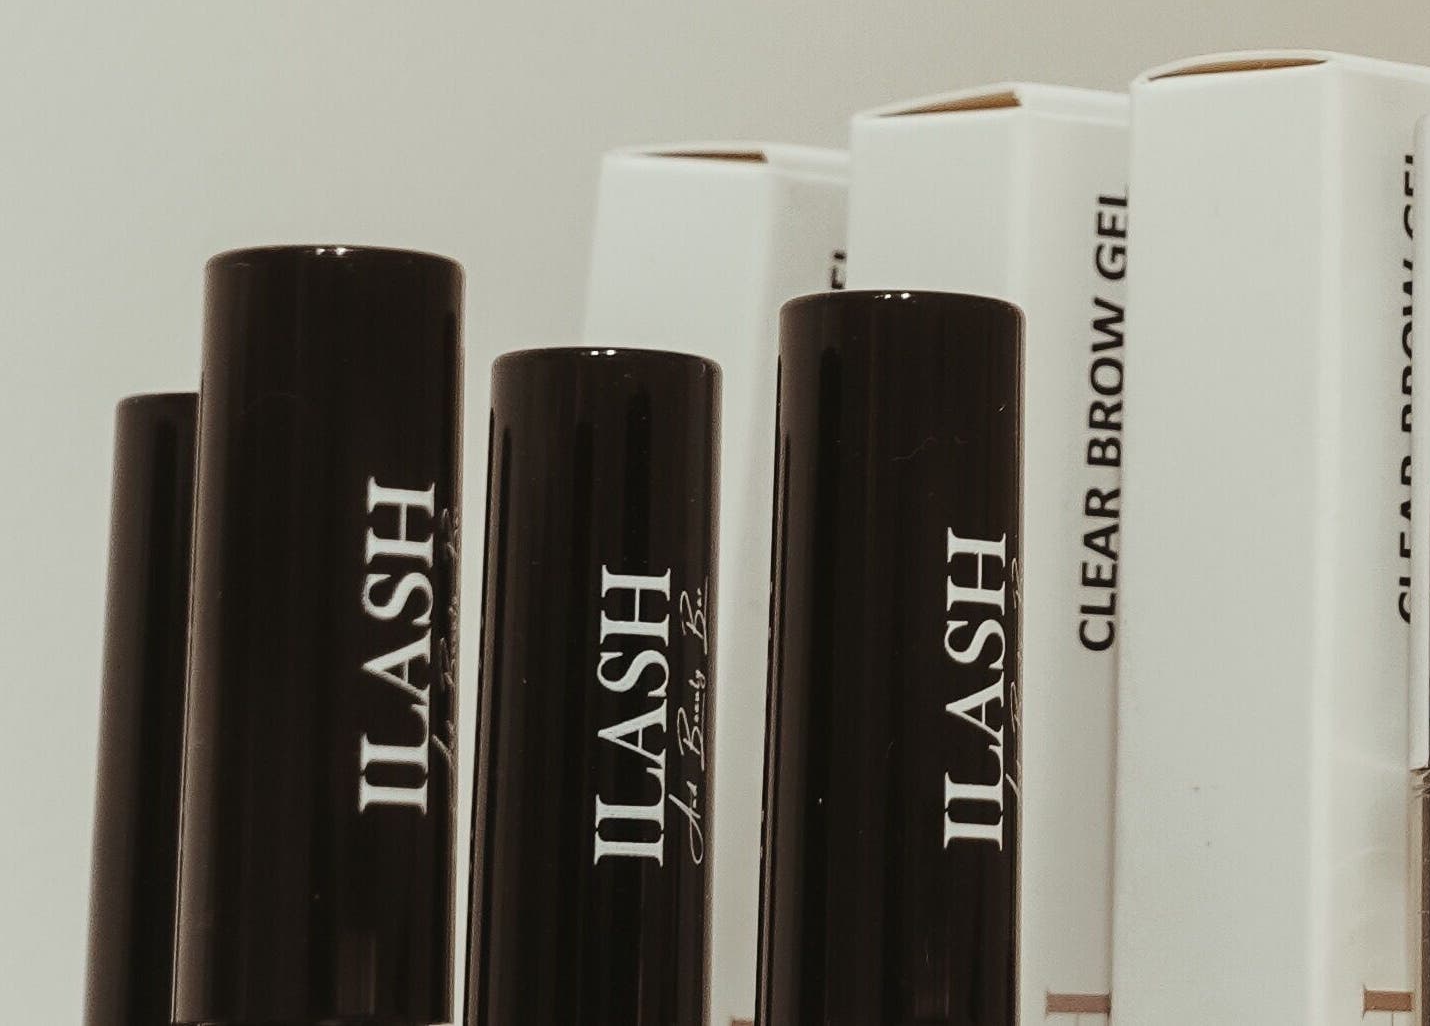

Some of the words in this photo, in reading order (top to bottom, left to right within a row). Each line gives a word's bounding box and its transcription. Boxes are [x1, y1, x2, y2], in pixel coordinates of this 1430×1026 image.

[1095, 186, 1128, 281] GEL
[1086, 298, 1125, 467] BROW
[358, 476, 435, 815] ILASH
[1078, 488, 1121, 652] CLEAR
[594, 565, 671, 867] ILASH
[944, 527, 1006, 851] ILASH
